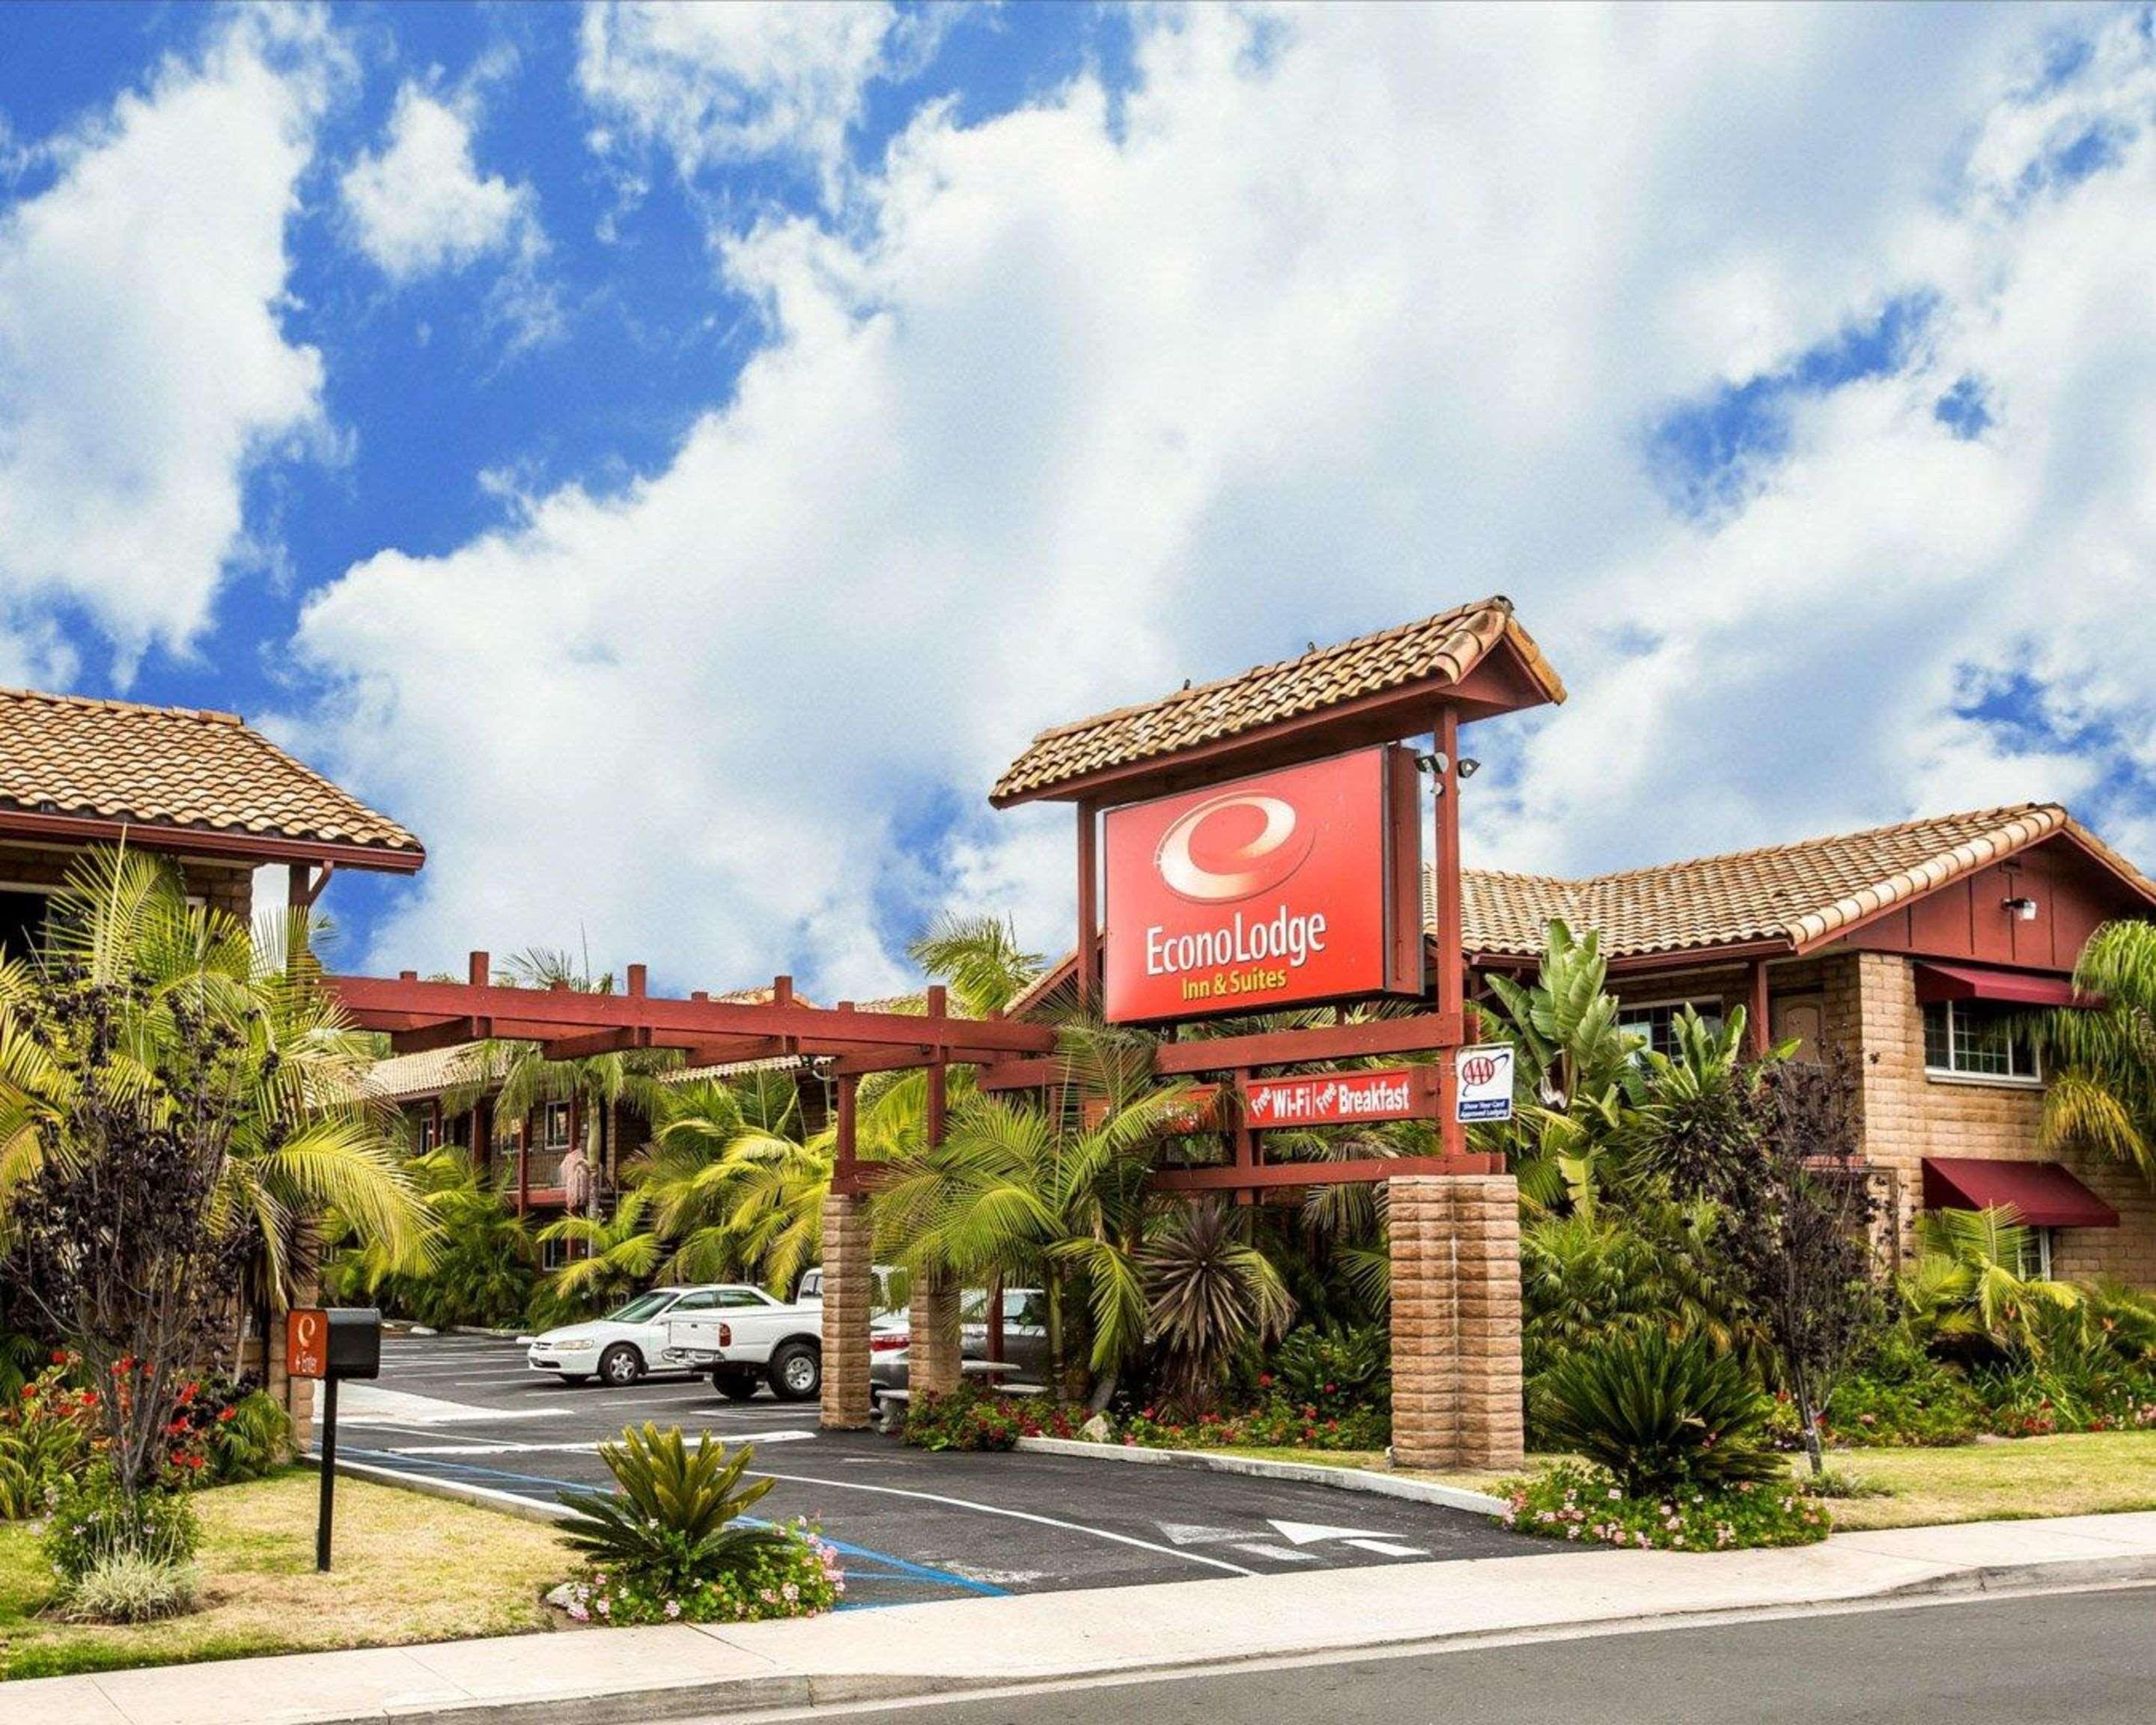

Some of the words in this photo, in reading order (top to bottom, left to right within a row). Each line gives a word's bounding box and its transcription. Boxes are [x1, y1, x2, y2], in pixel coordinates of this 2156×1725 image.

[1147, 904, 1327, 975] EconoLodge
[1182, 977, 1211, 1000] Inn
[1213, 973, 1227, 996] &
[1229, 967, 1287, 993] Suites
[1251, 1086, 1273, 1118] Free
[1272, 1087, 1311, 1119] Wi-Fi
[1315, 1082, 1337, 1115] Free
[1338, 1080, 1410, 1114] Breakfast
